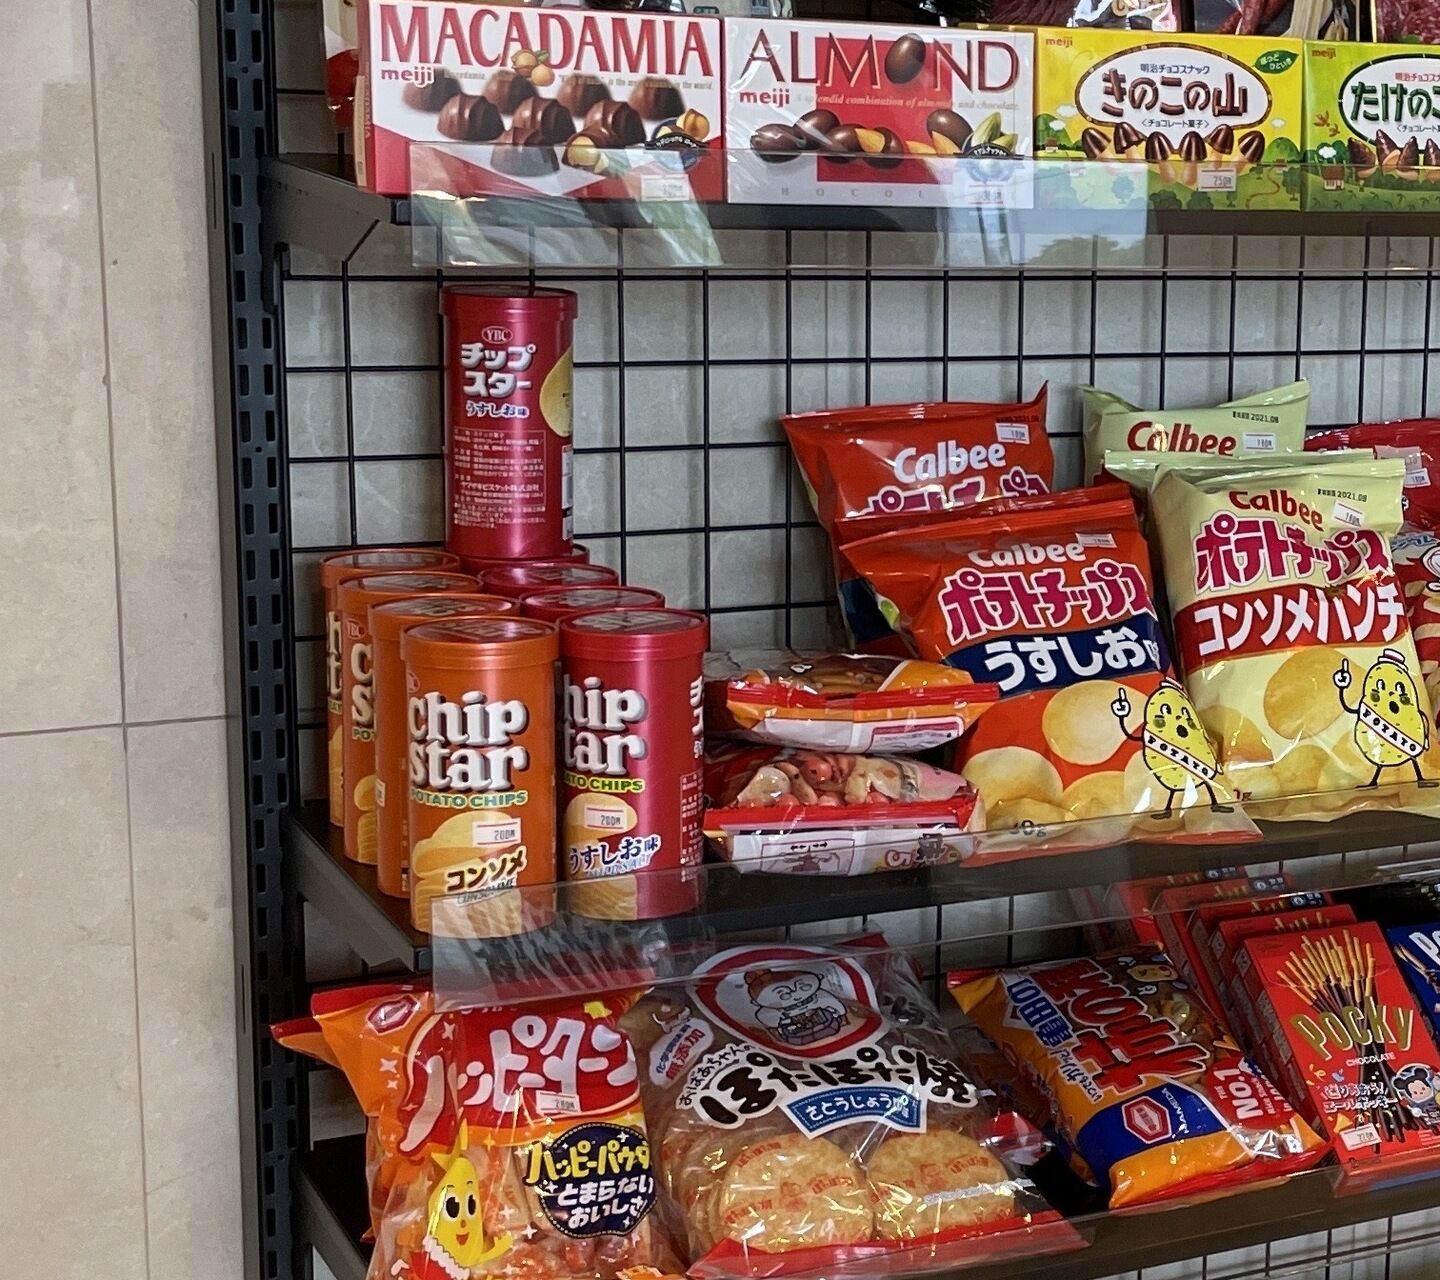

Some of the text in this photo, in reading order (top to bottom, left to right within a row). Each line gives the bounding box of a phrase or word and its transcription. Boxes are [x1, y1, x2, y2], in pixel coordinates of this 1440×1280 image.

[379, 3, 714, 77] MACADAMIA
[1045, 37, 1073, 48] meiji
[1311, 47, 1338, 58] meiji
[380, 66, 434, 87] meiji
[1140, 62, 1210, 75] 明治チョコスナック
[739, 88, 790, 108] meiji
[1101, 67, 1248, 117] きのこの山
[483, 327, 512, 343] YBC
[460, 341, 537, 371] チップ
[462, 370, 534, 399] スター
[465, 400, 530, 418] うすしお味
[1126, 420, 1238, 457] Calbee
[892, 439, 1007, 485] Calbee
[1227, 489, 1325, 533] Calbee
[968, 541, 1088, 568] Calbee
[1192, 513, 1396, 595] ポテトチップス
[939, 558, 1159, 646] ポテトチップス
[408, 689, 529, 747] chip
[1361, 707, 1421, 755] POTATO
[409, 742, 529, 792] star
[410, 790, 528, 809] POTATO CHIPS
[589, 777, 644, 793] CHIPS
[568, 835, 661, 873] うすしお味
[446, 848, 527, 893] コンソメ
[1345, 1051, 1397, 1067] CHOCOLATE
[700, 1044, 979, 1126] ぽたぽた焼
[557, 1175, 656, 1203] とまらない
